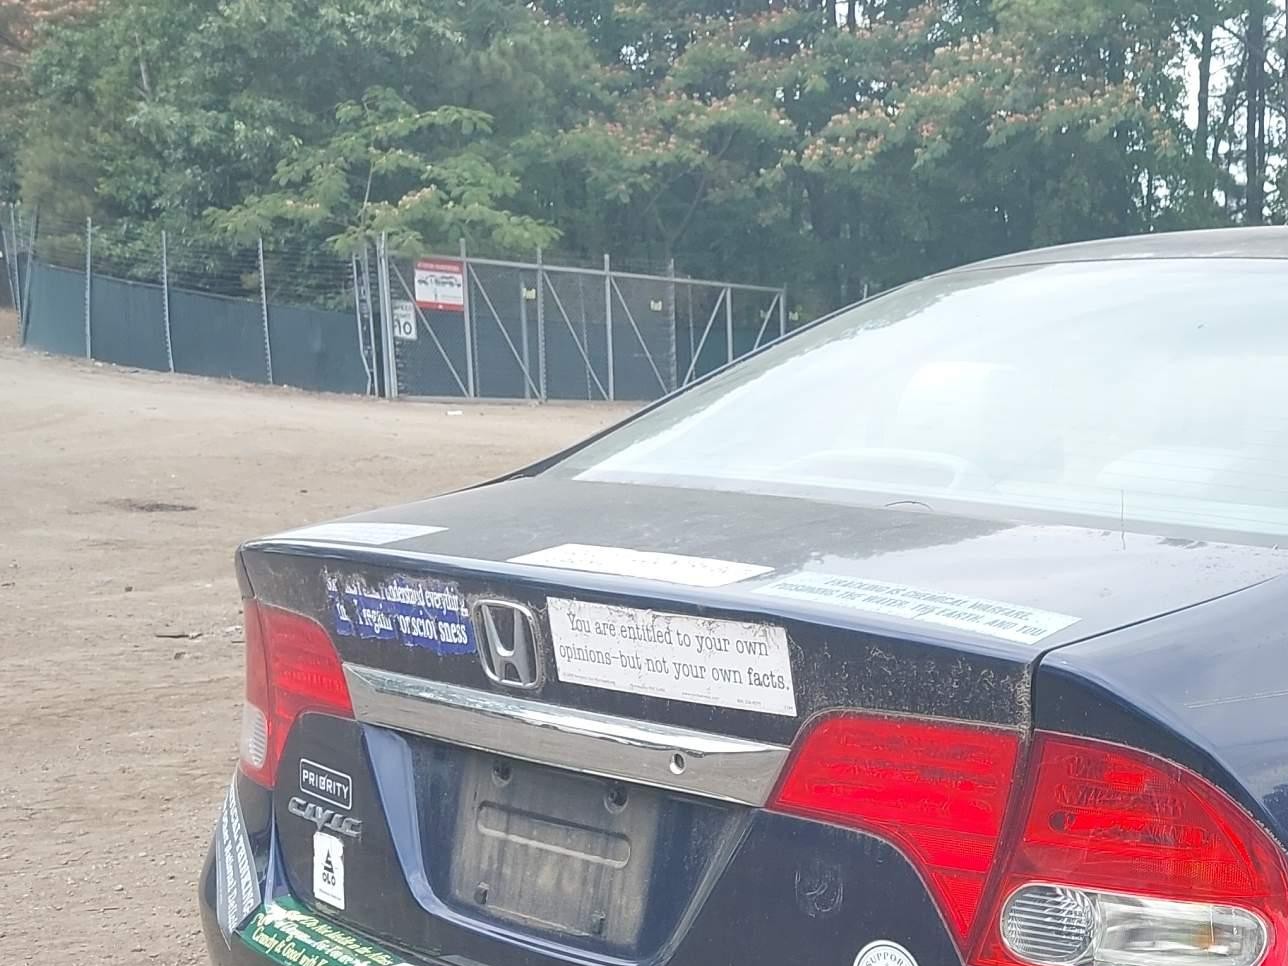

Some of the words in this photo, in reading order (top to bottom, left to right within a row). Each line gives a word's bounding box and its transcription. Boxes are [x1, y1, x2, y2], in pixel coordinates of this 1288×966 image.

[567, 611, 590, 633] You
[595, 620, 615, 636] are
[621, 624, 673, 645] entitled
[676, 631, 691, 647] to
[696, 634, 730, 654] your
[736, 640, 768, 656] own
[646, 657, 669, 674] not
[672, 660, 707, 681] your
[712, 667, 743, 685] own
[747, 666, 790, 691] facts.
[302, 769, 349, 799] PRIORITY
[288, 796, 363, 839] CIVIC
